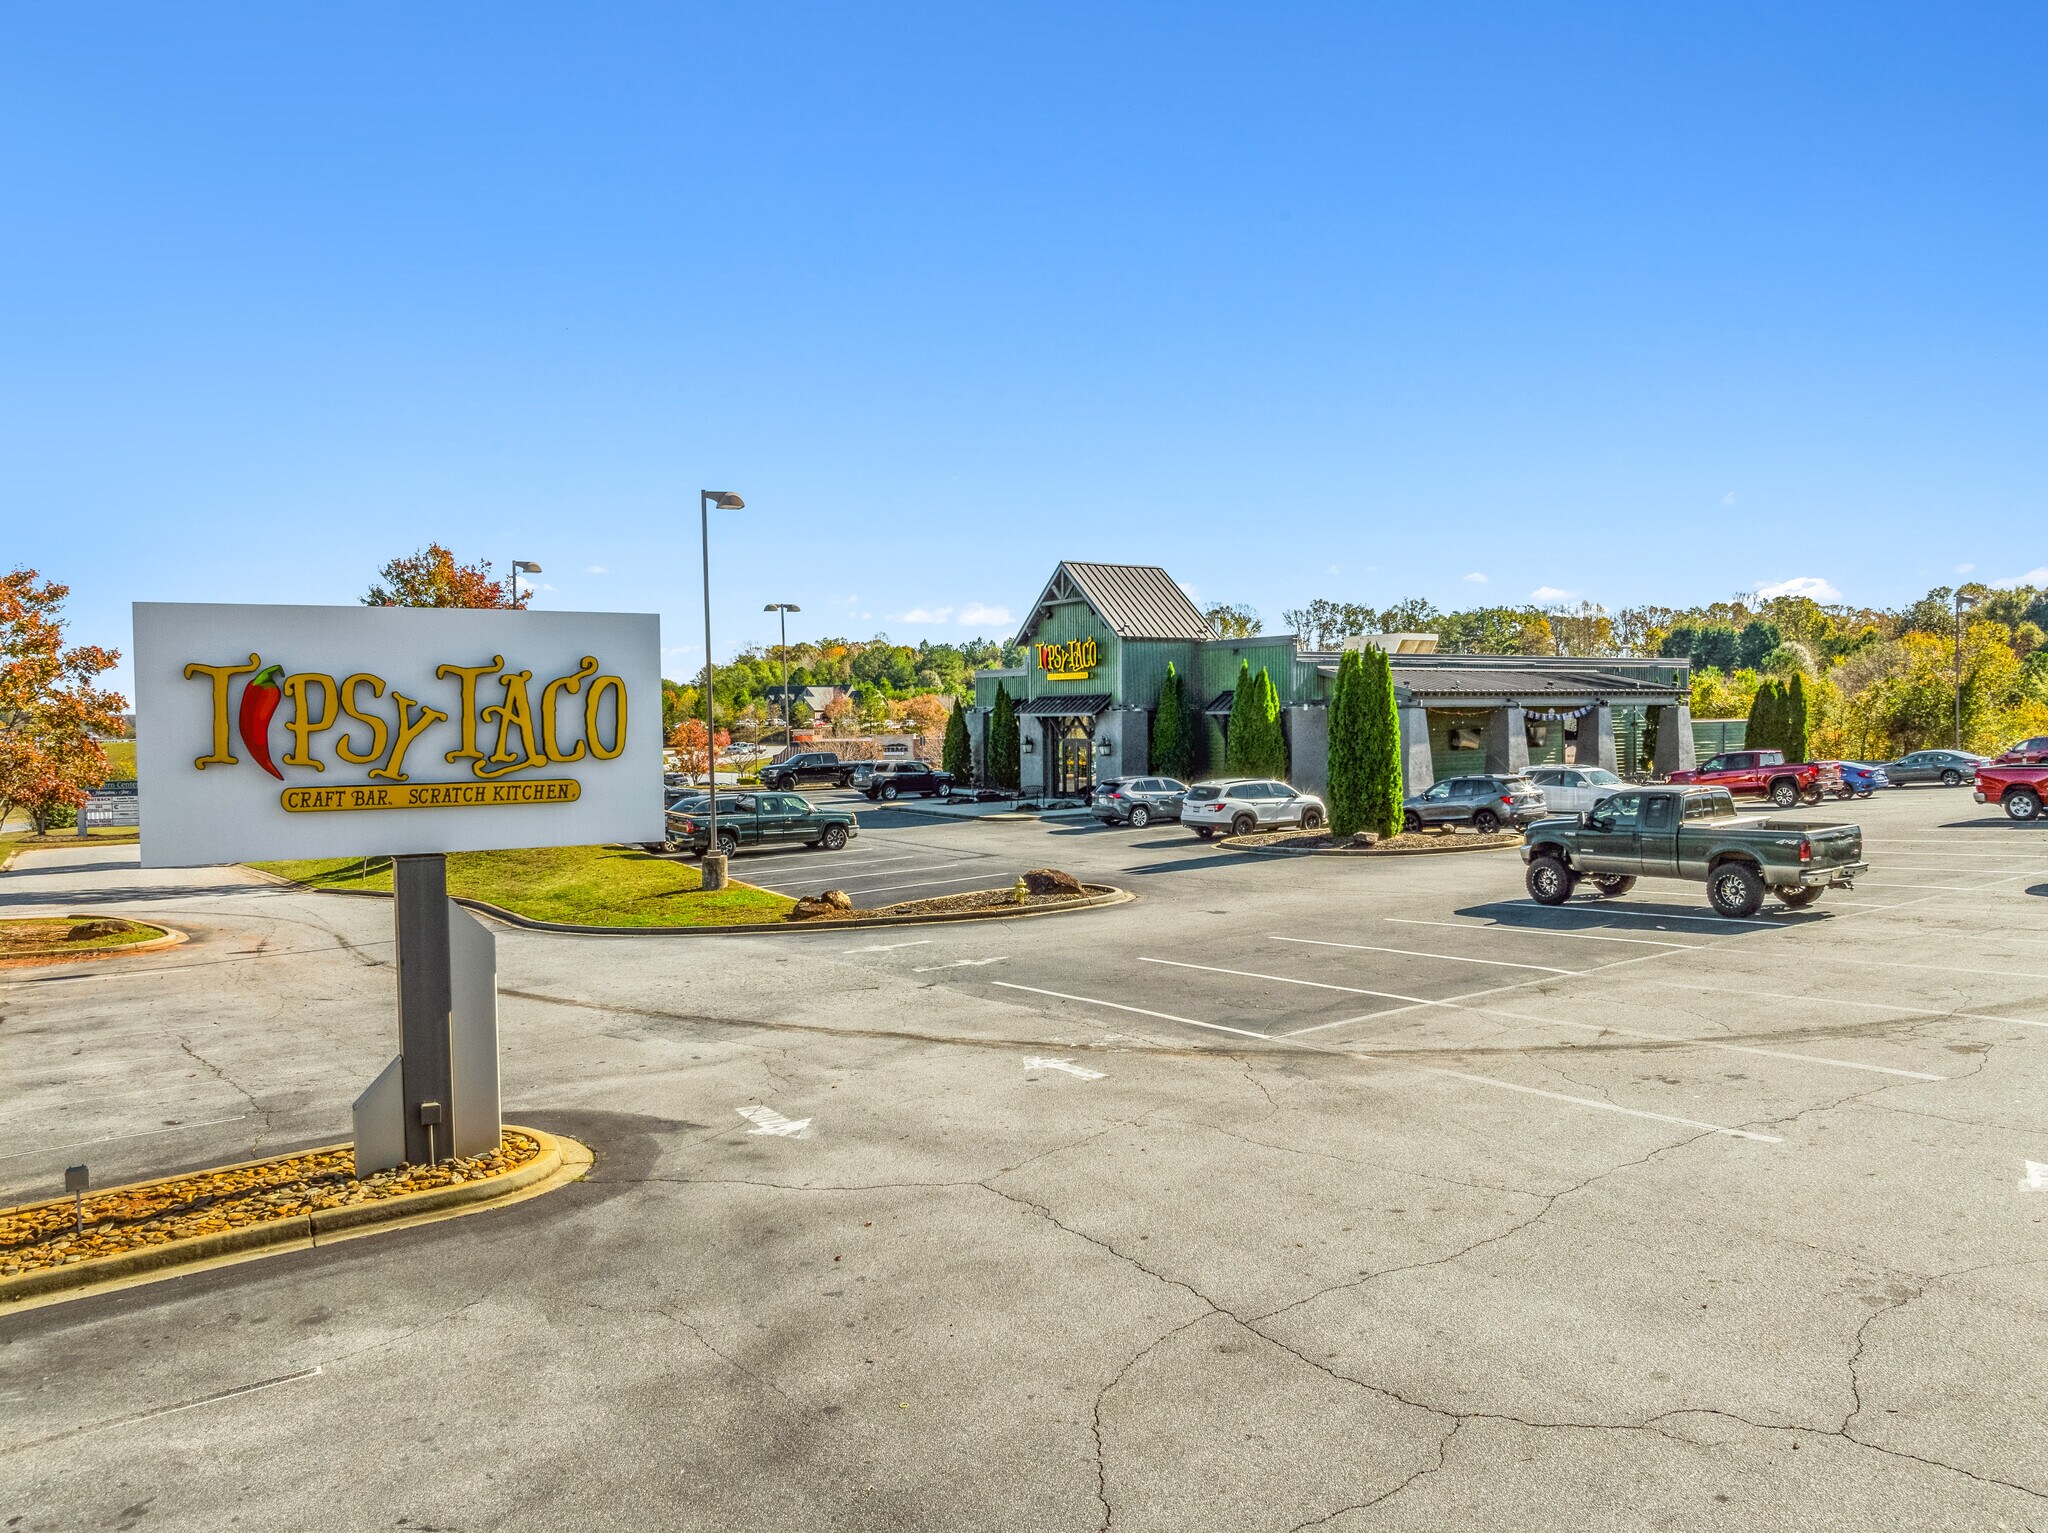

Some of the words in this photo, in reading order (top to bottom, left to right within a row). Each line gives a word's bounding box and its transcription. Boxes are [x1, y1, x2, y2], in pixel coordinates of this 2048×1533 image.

[1035, 641, 1070, 672] TIPSY
[1066, 636, 1097, 672] TACO
[184, 653, 448, 781] TIPSY
[436, 655, 628, 778] TACO
[287, 790, 346, 808] CRAFT
[408, 786, 486, 804] SCRATCH
